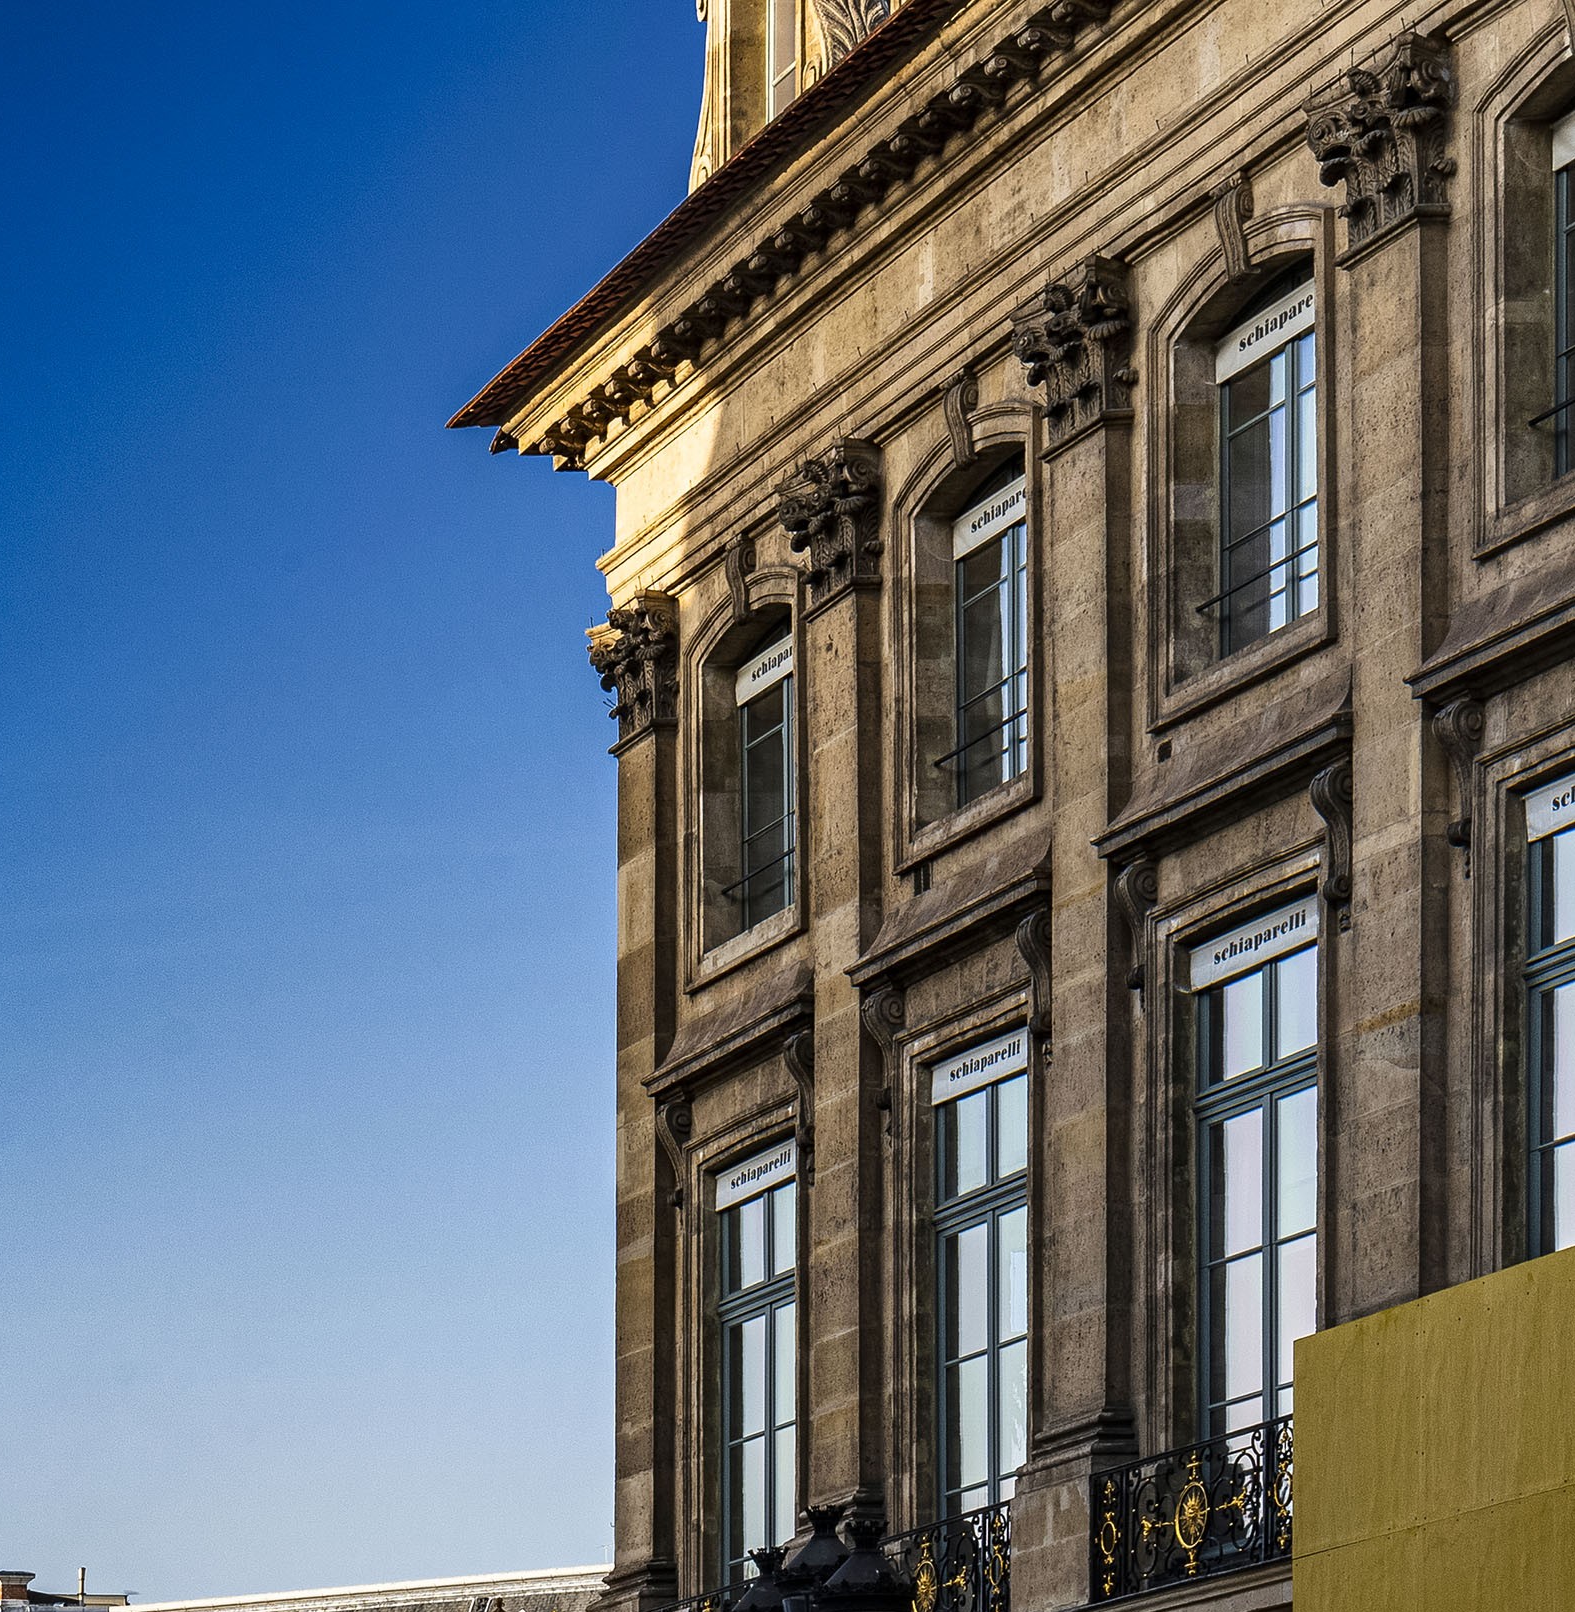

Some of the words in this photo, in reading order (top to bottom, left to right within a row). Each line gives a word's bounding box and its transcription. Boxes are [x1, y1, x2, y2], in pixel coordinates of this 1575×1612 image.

[1214, 909, 1306, 965] schiaparelli
[950, 1039, 1020, 1082] schiaparelli
[731, 1148, 791, 1190] schiaparelli
